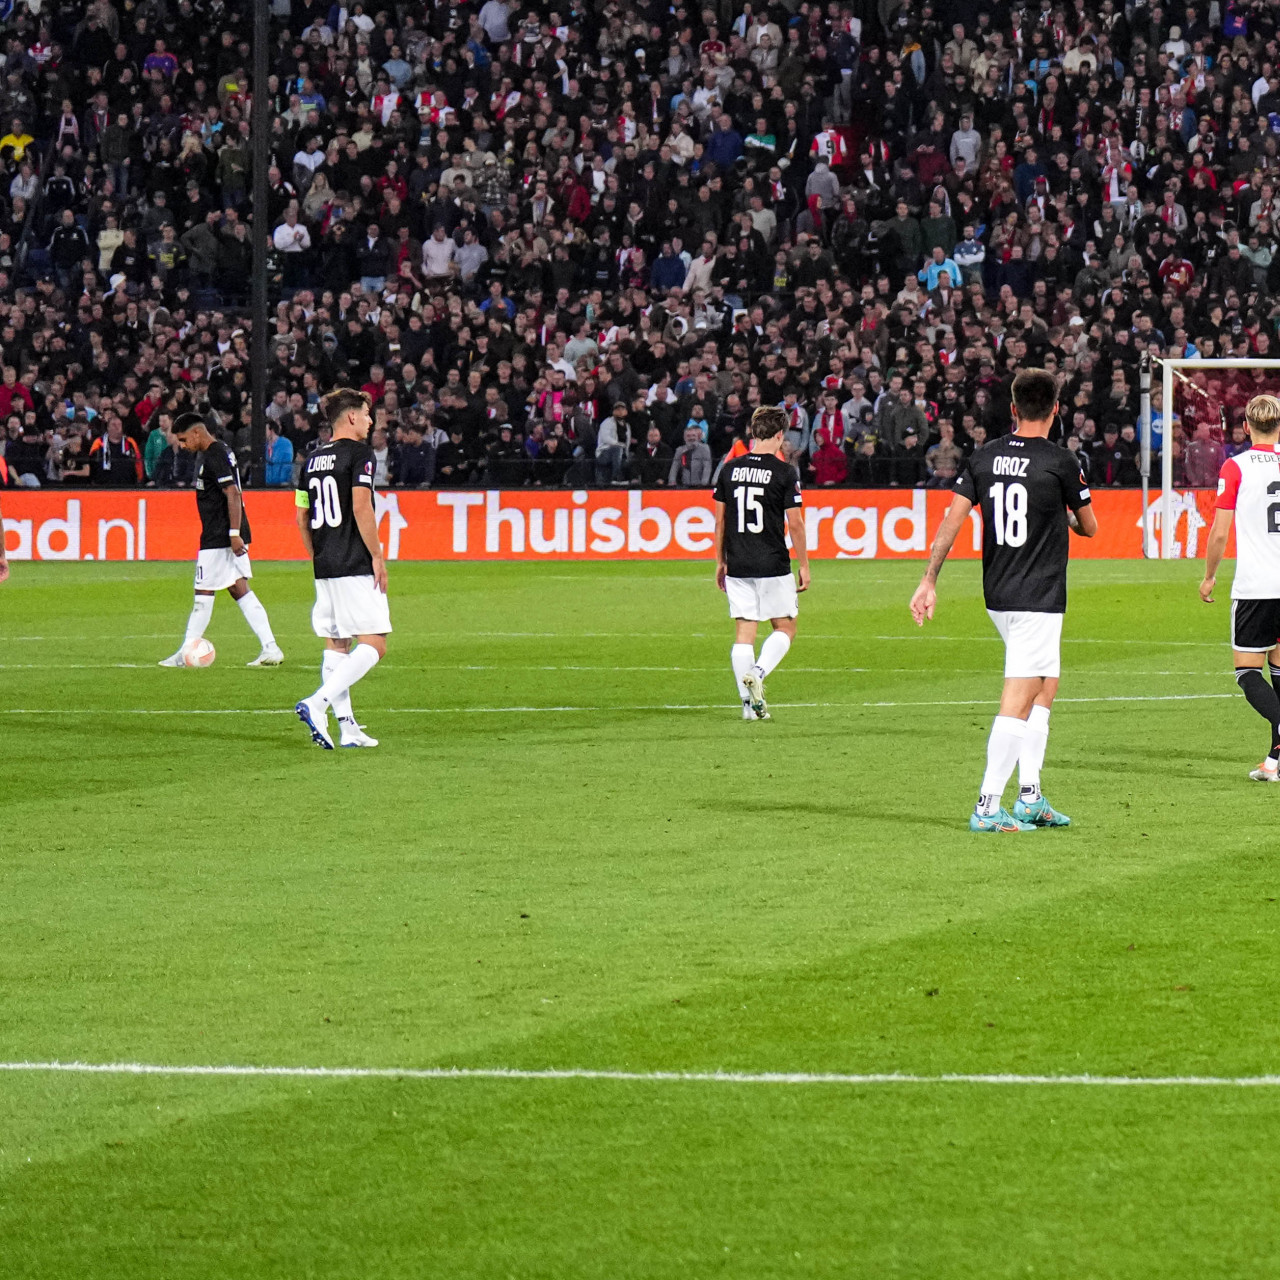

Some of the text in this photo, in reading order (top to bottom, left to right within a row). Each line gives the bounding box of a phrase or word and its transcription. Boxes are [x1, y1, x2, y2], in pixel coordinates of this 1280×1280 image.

[307, 454, 337, 473] LJUBIC
[731, 467, 772, 485] BØVING
[993, 456, 1031, 477] OROZ
[308, 475, 343, 530] 30
[733, 486, 765, 534] 15
[989, 482, 1028, 548] 18
